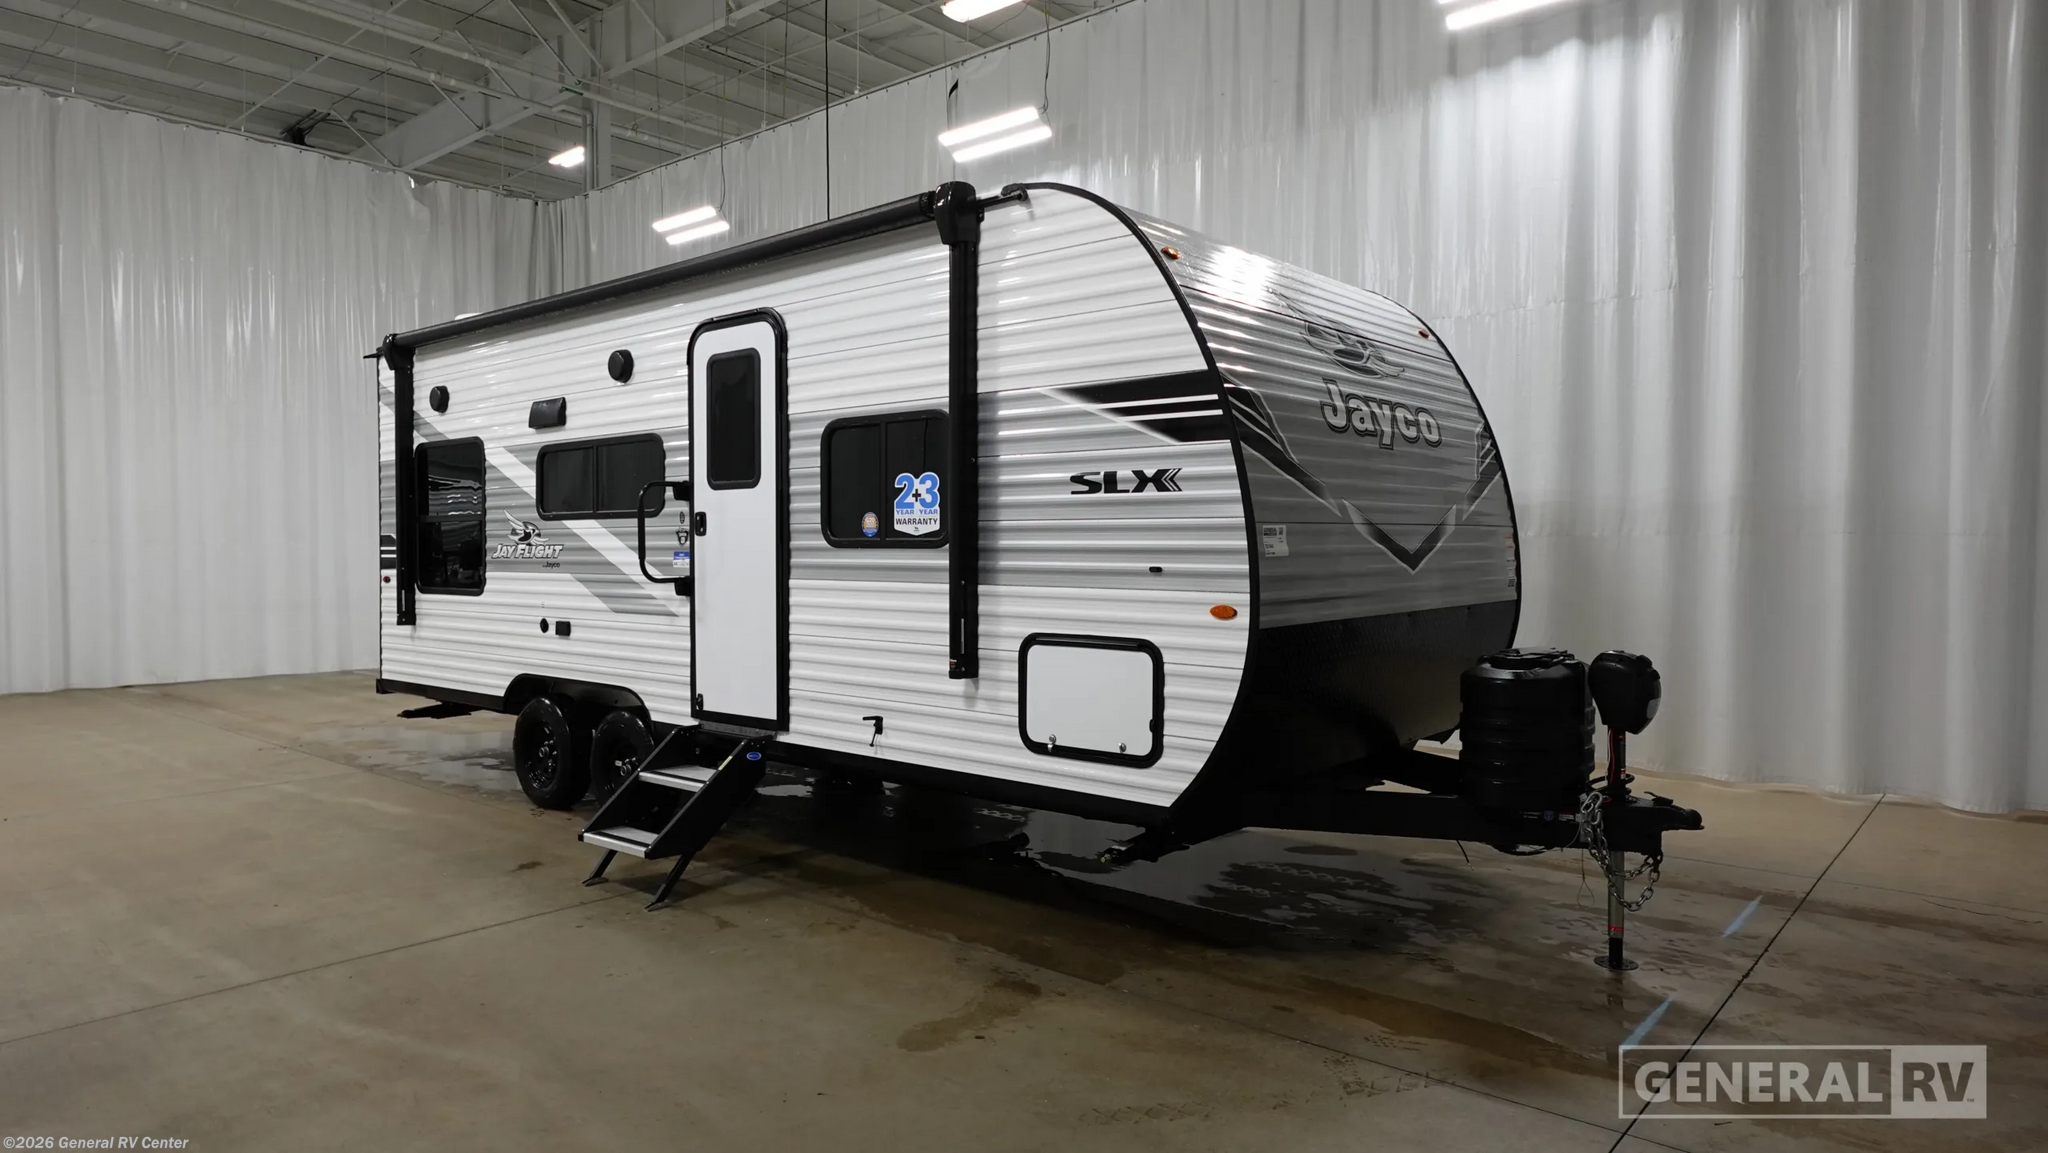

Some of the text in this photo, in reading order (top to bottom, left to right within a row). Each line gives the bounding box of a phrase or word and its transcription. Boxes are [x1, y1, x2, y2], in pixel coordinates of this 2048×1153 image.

[1320, 378, 1442, 450] Jayco
[1070, 468, 1183, 495] SLX
[491, 543, 564, 559] JAY FLIGHT
